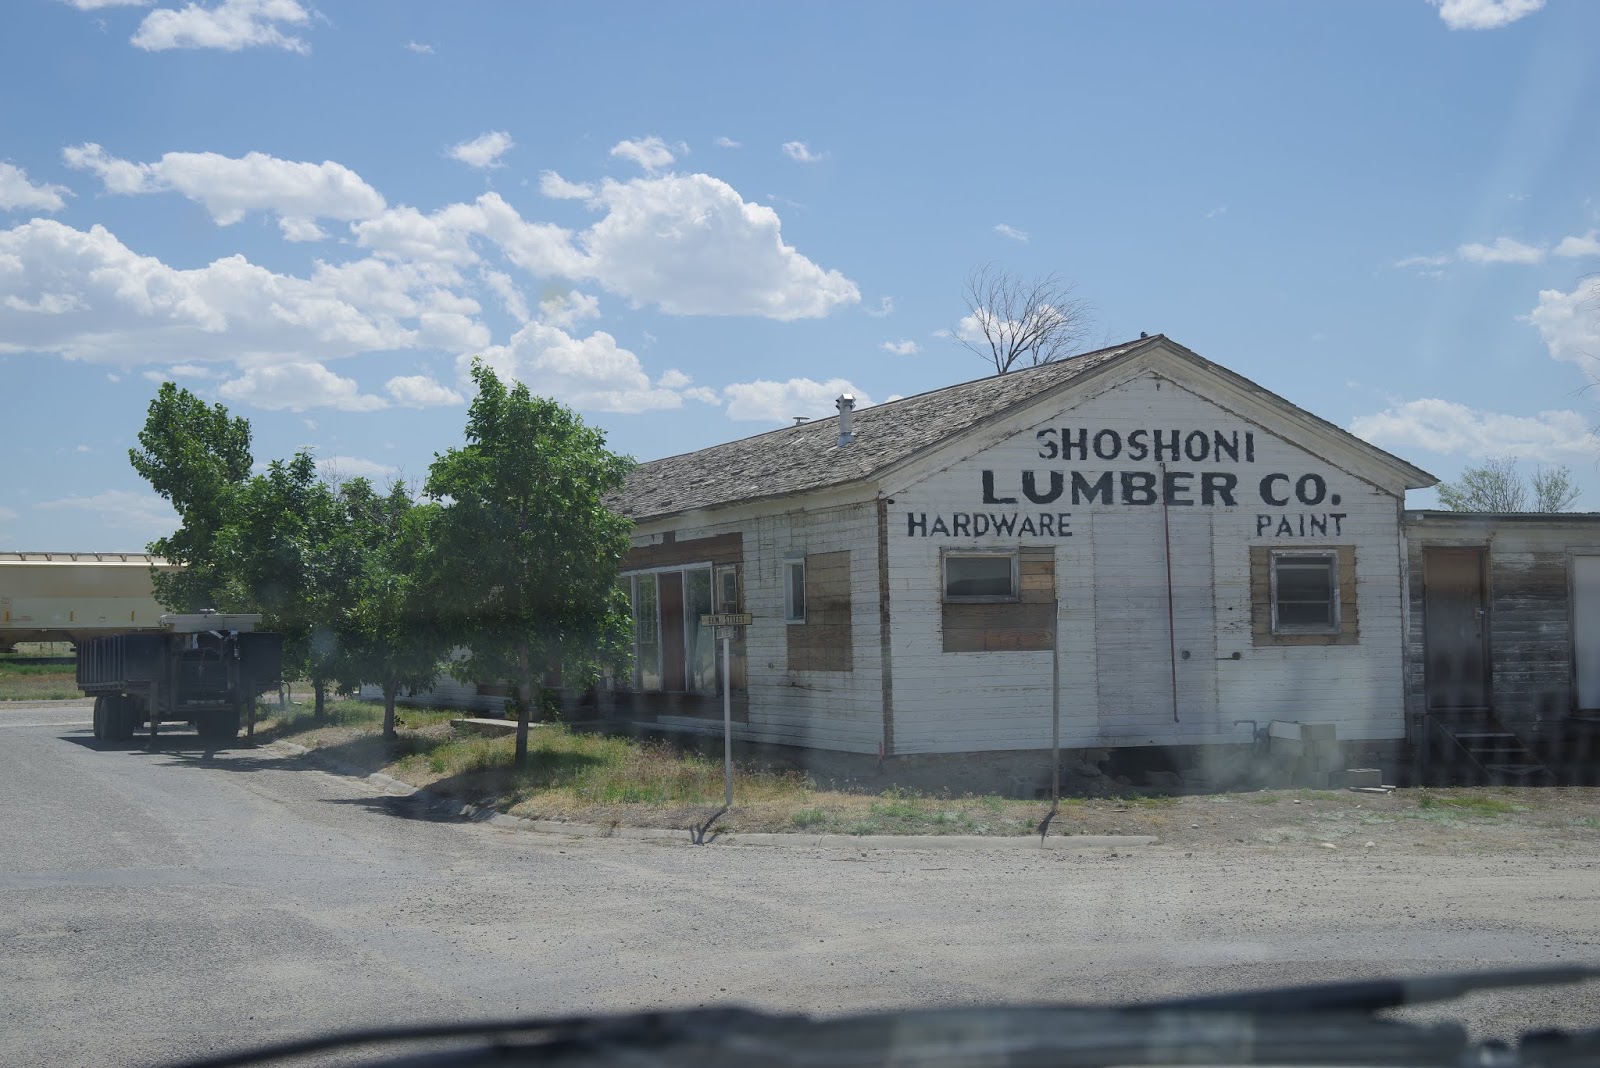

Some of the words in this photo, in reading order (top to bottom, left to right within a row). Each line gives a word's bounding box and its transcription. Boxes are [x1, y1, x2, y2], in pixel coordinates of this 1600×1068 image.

[1036, 427, 1254, 463] SHOSHONI
[982, 470, 1238, 506] LUMBER
[1259, 473, 1342, 506] CO.
[907, 512, 1073, 537] HARDWARE
[1256, 513, 1347, 537] PAINT
[708, 616, 720, 625] ELM
[724, 614, 745, 625] STREET
